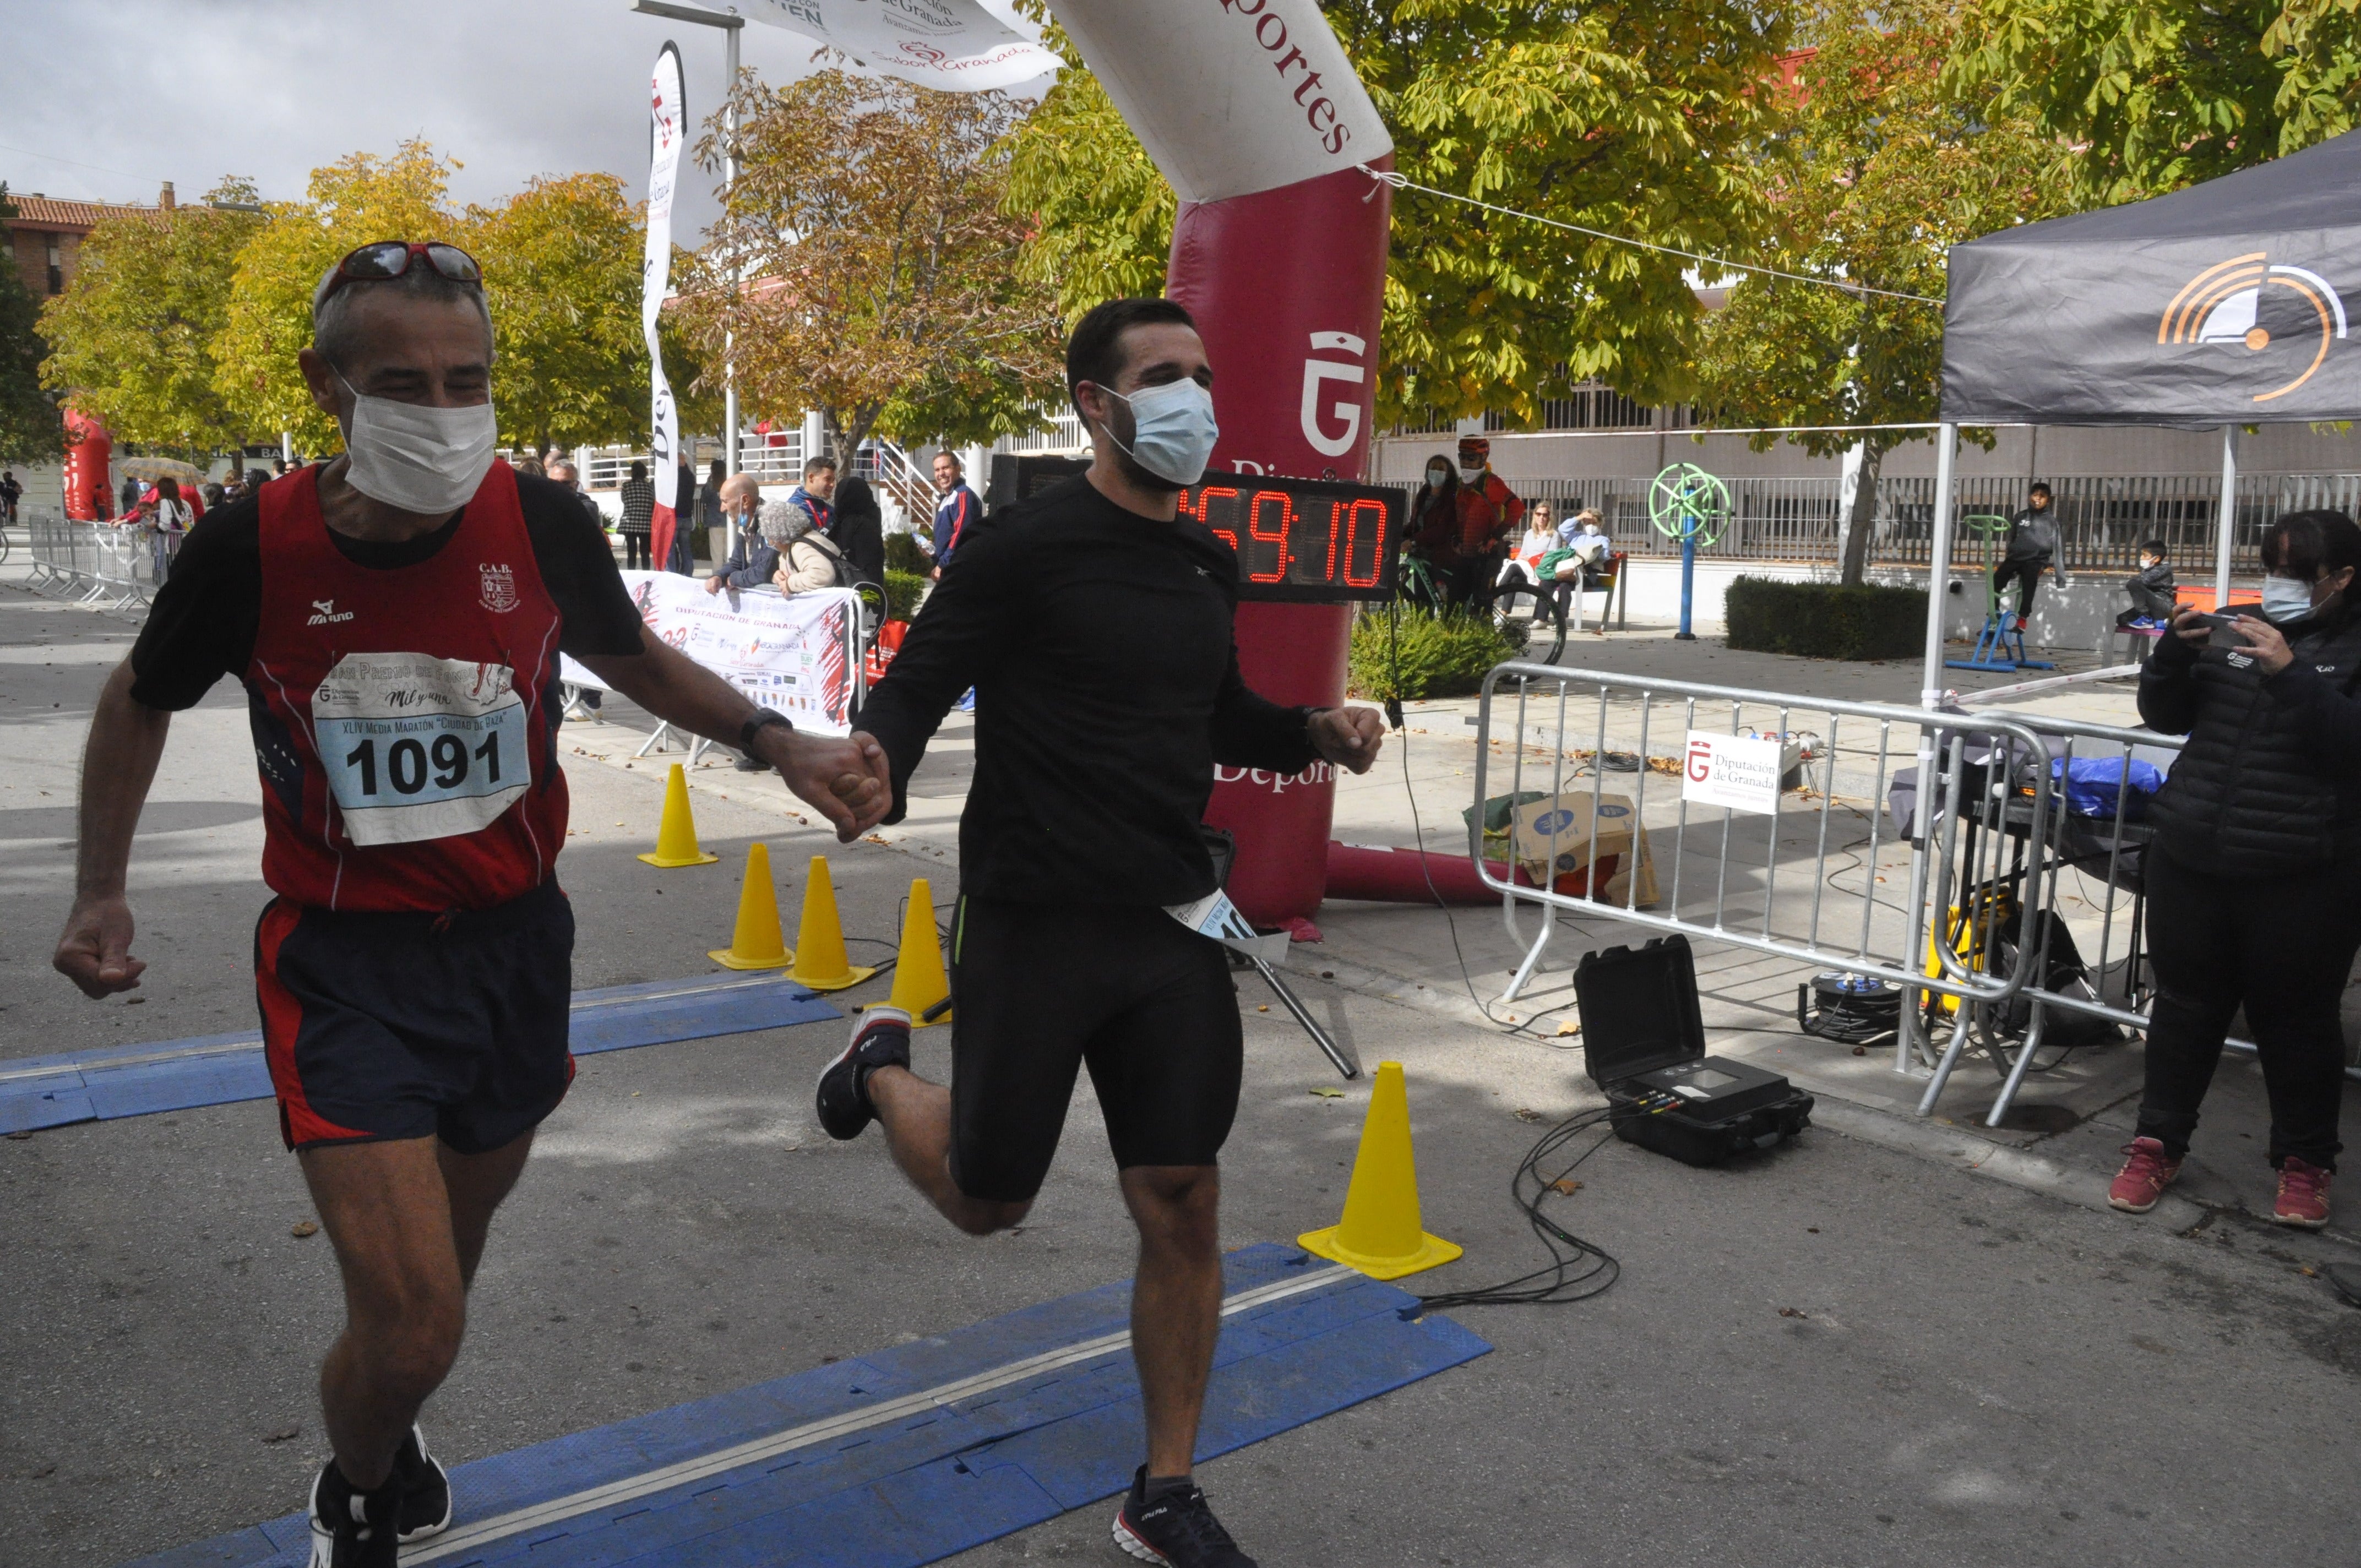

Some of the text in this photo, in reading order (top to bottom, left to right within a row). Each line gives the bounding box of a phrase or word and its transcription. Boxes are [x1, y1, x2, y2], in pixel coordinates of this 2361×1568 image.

[900, 0, 963, 27] Granada
[871, 47, 1031, 70] Sabor Granada
[479, 563, 513, 574] C.A.B.
[738, 616, 750, 624] DE
[753, 619, 801, 630] GRANADA
[360, 662, 411, 680] PREMIO
[385, 690, 417, 707] Mil
[342, 722, 363, 734] XLIV
[366, 722, 392, 734] MEDIA
[395, 719, 434, 734] MARATÓN
[474, 721, 484, 731] DE
[346, 731, 501, 796] 1091
[1716, 754, 1775, 775] Diputación
[1713, 769, 1775, 790] de Granada
